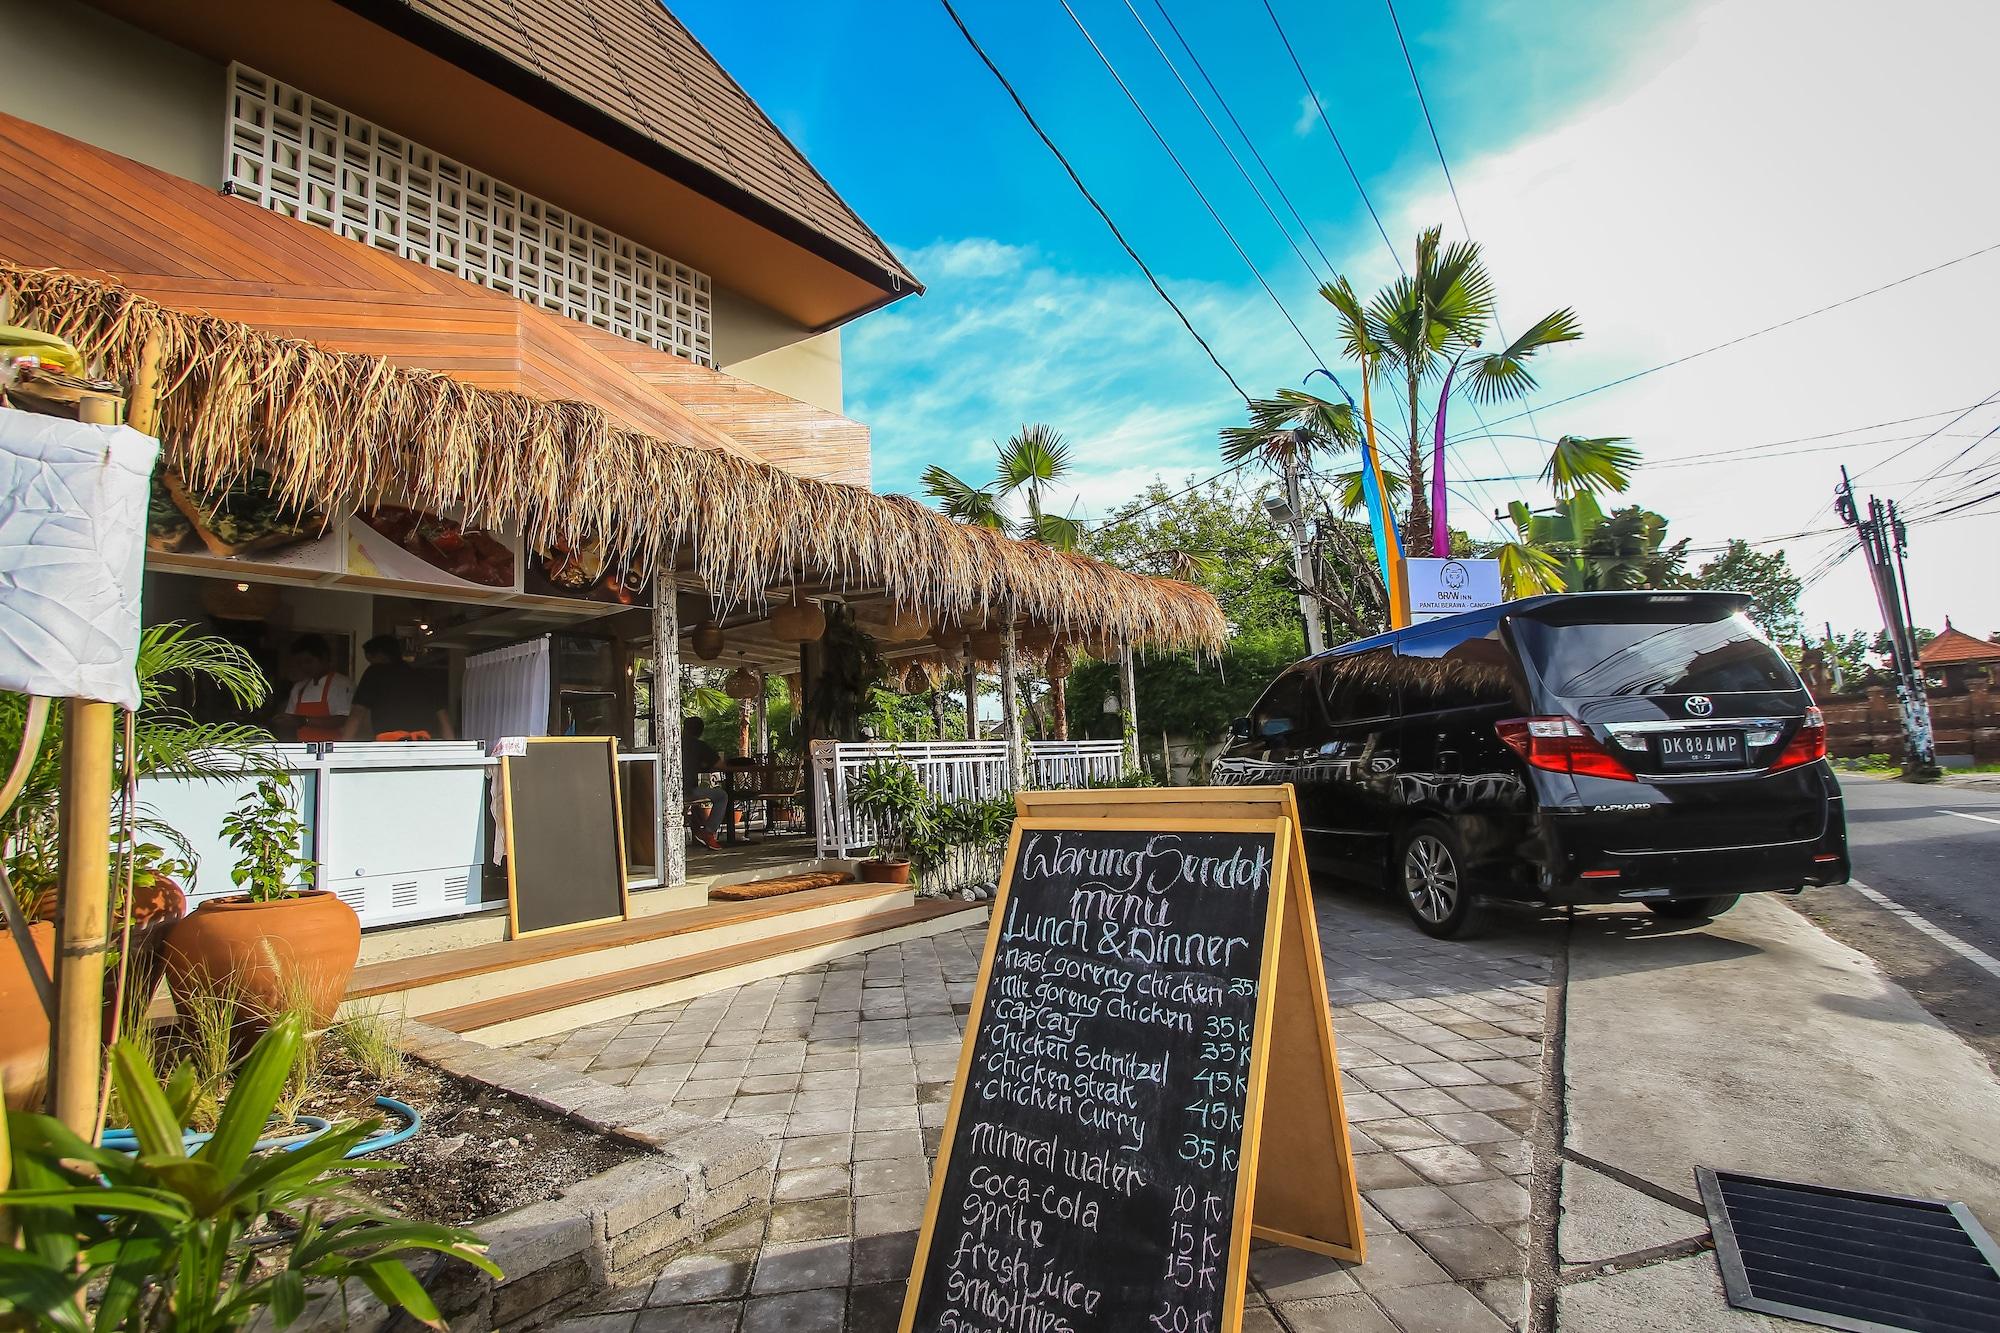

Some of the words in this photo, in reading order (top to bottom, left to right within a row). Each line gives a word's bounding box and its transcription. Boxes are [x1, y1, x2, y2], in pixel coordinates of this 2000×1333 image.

[1593, 803, 1651, 812] ALPHARD
[1023, 833, 1147, 893] Warung
[1145, 834, 1272, 895] Sendok
[1002, 896, 1090, 953] Lunch
[1097, 921, 1125, 960] &
[1127, 927, 1250, 967] Dinner
[1041, 957, 1135, 996] goreng
[1031, 981, 1102, 1017] goreng
[1074, 1044, 1170, 1087] Schnitzel
[1074, 1071, 1138, 1109] Steak
[1078, 1098, 1147, 1150] Curry
